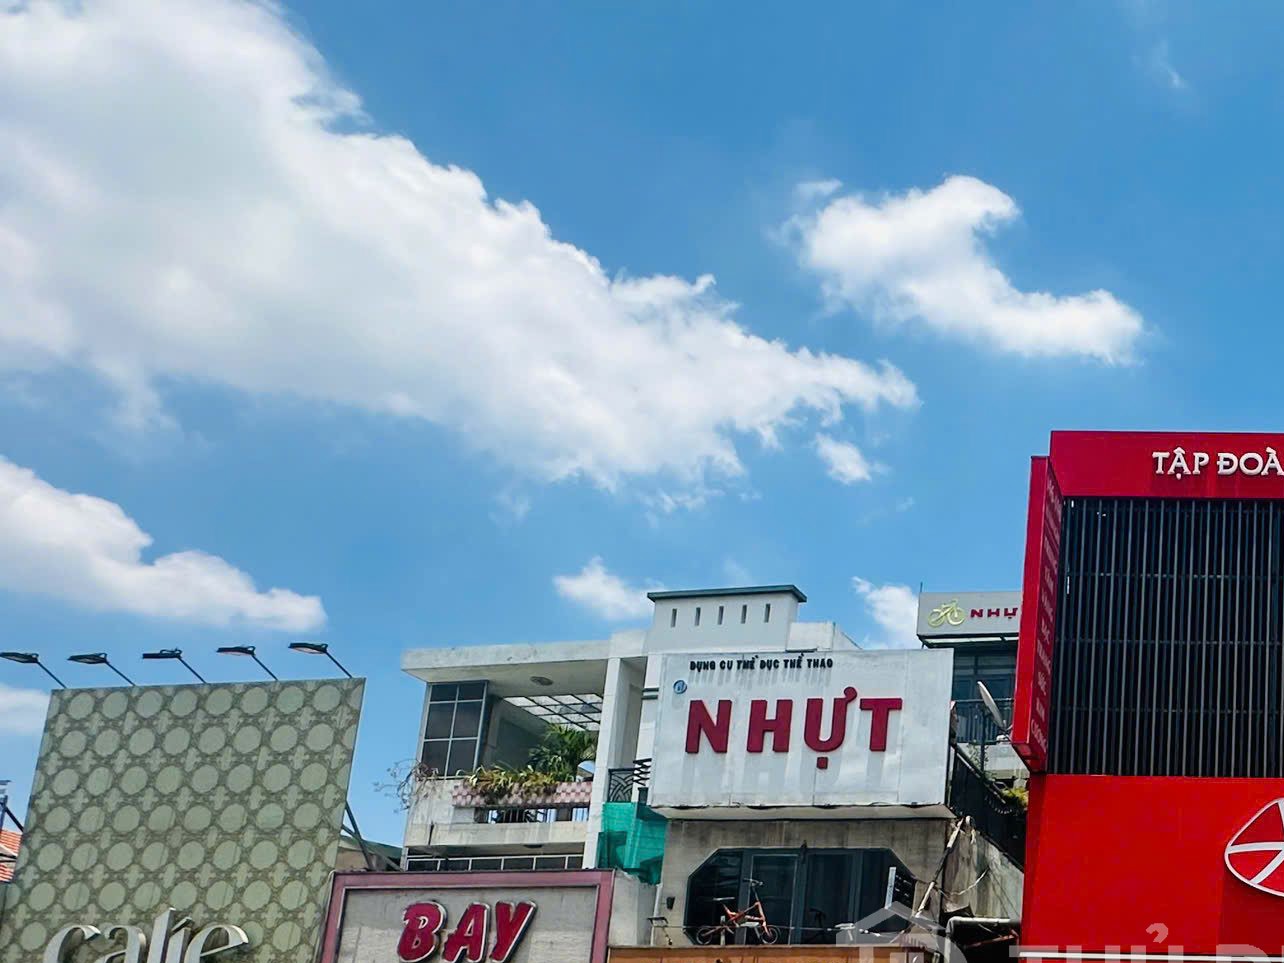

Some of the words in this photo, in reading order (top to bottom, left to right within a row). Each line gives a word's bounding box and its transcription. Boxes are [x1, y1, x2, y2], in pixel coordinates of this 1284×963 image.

[1152, 447, 1210, 480] TẬP
[970, 607, 1019, 620] NHỰ
[806, 658, 834, 669] THAO
[685, 686, 903, 770] NHỰT
